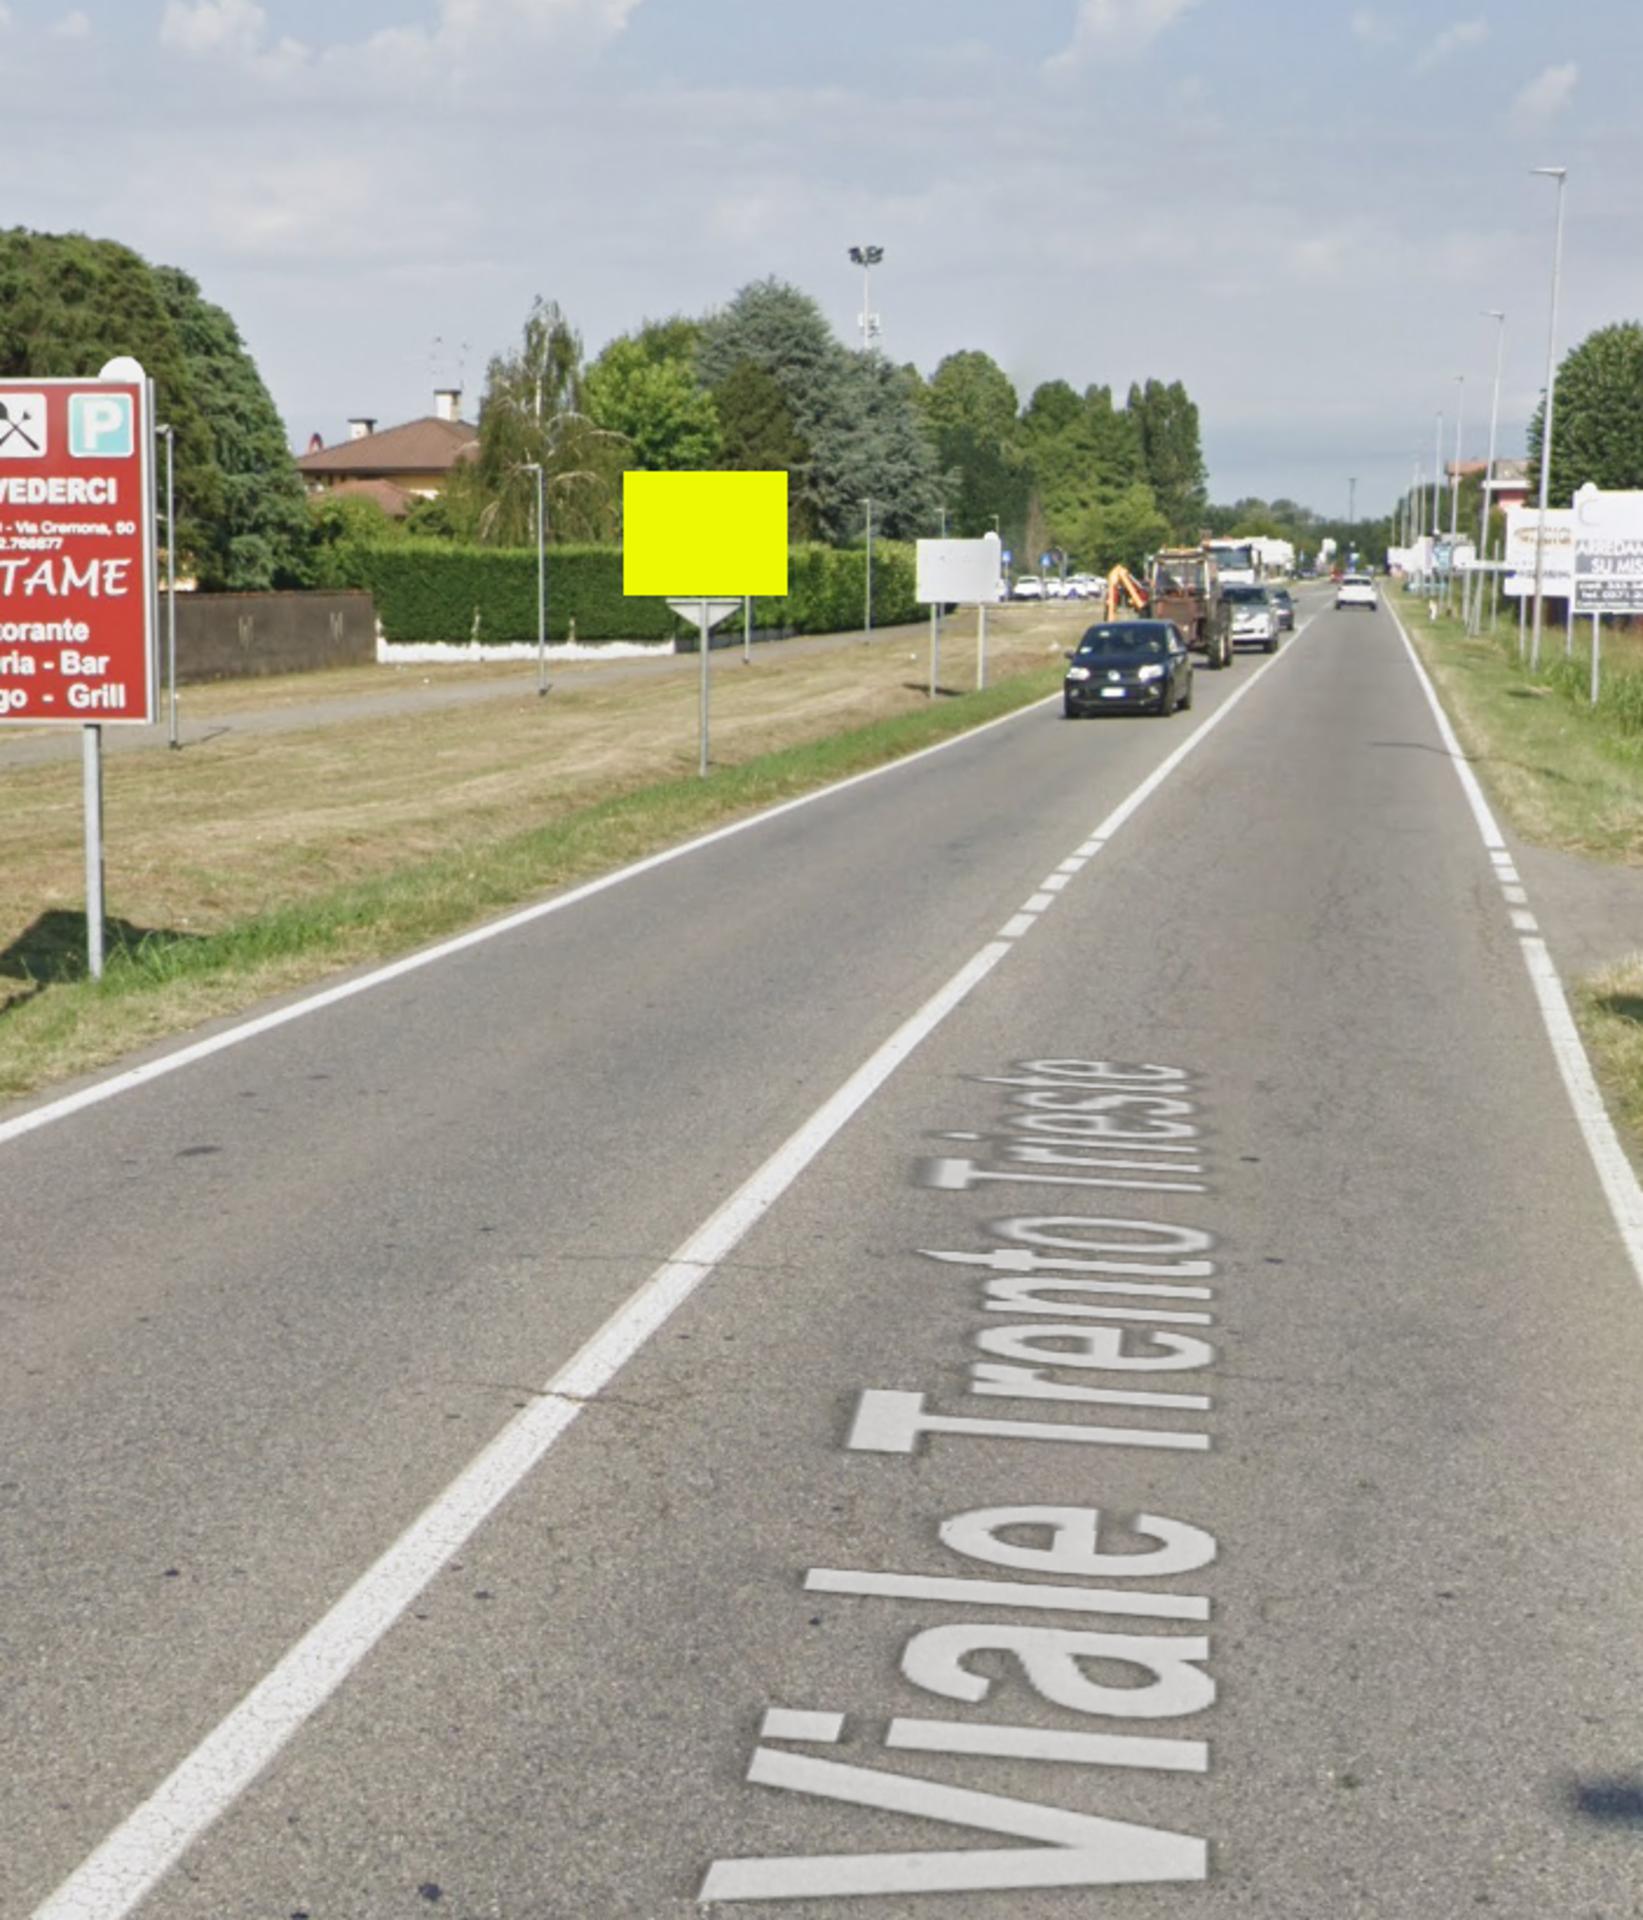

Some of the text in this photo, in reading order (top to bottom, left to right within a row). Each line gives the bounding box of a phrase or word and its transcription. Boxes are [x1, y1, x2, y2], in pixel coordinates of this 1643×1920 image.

[0, 618, 90, 642] orante
[60, 649, 110, 675] Bar
[67, 682, 126, 708] Grill
